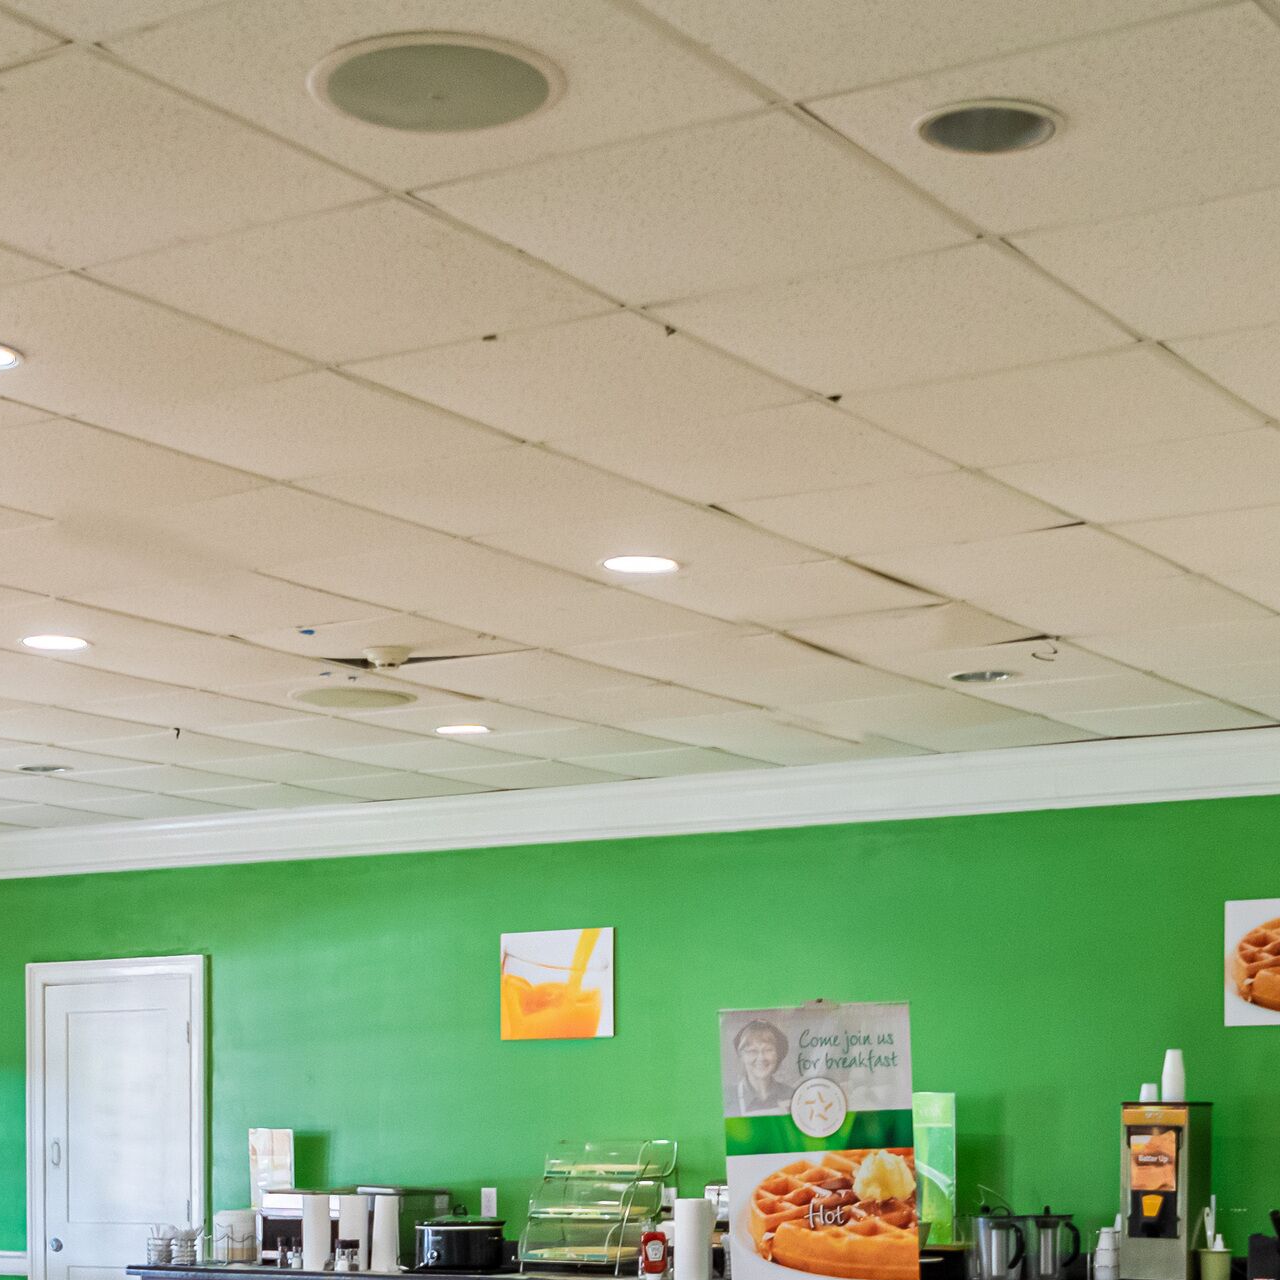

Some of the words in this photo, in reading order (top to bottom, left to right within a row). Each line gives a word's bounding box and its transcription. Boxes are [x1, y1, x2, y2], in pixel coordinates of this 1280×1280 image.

[799, 1029, 839, 1049] Come
[842, 1030, 872, 1054] join
[878, 1033, 894, 1046] us
[796, 1053, 820, 1076] for
[825, 1050, 898, 1072] breakfast
[803, 1201, 845, 1229] Hot
